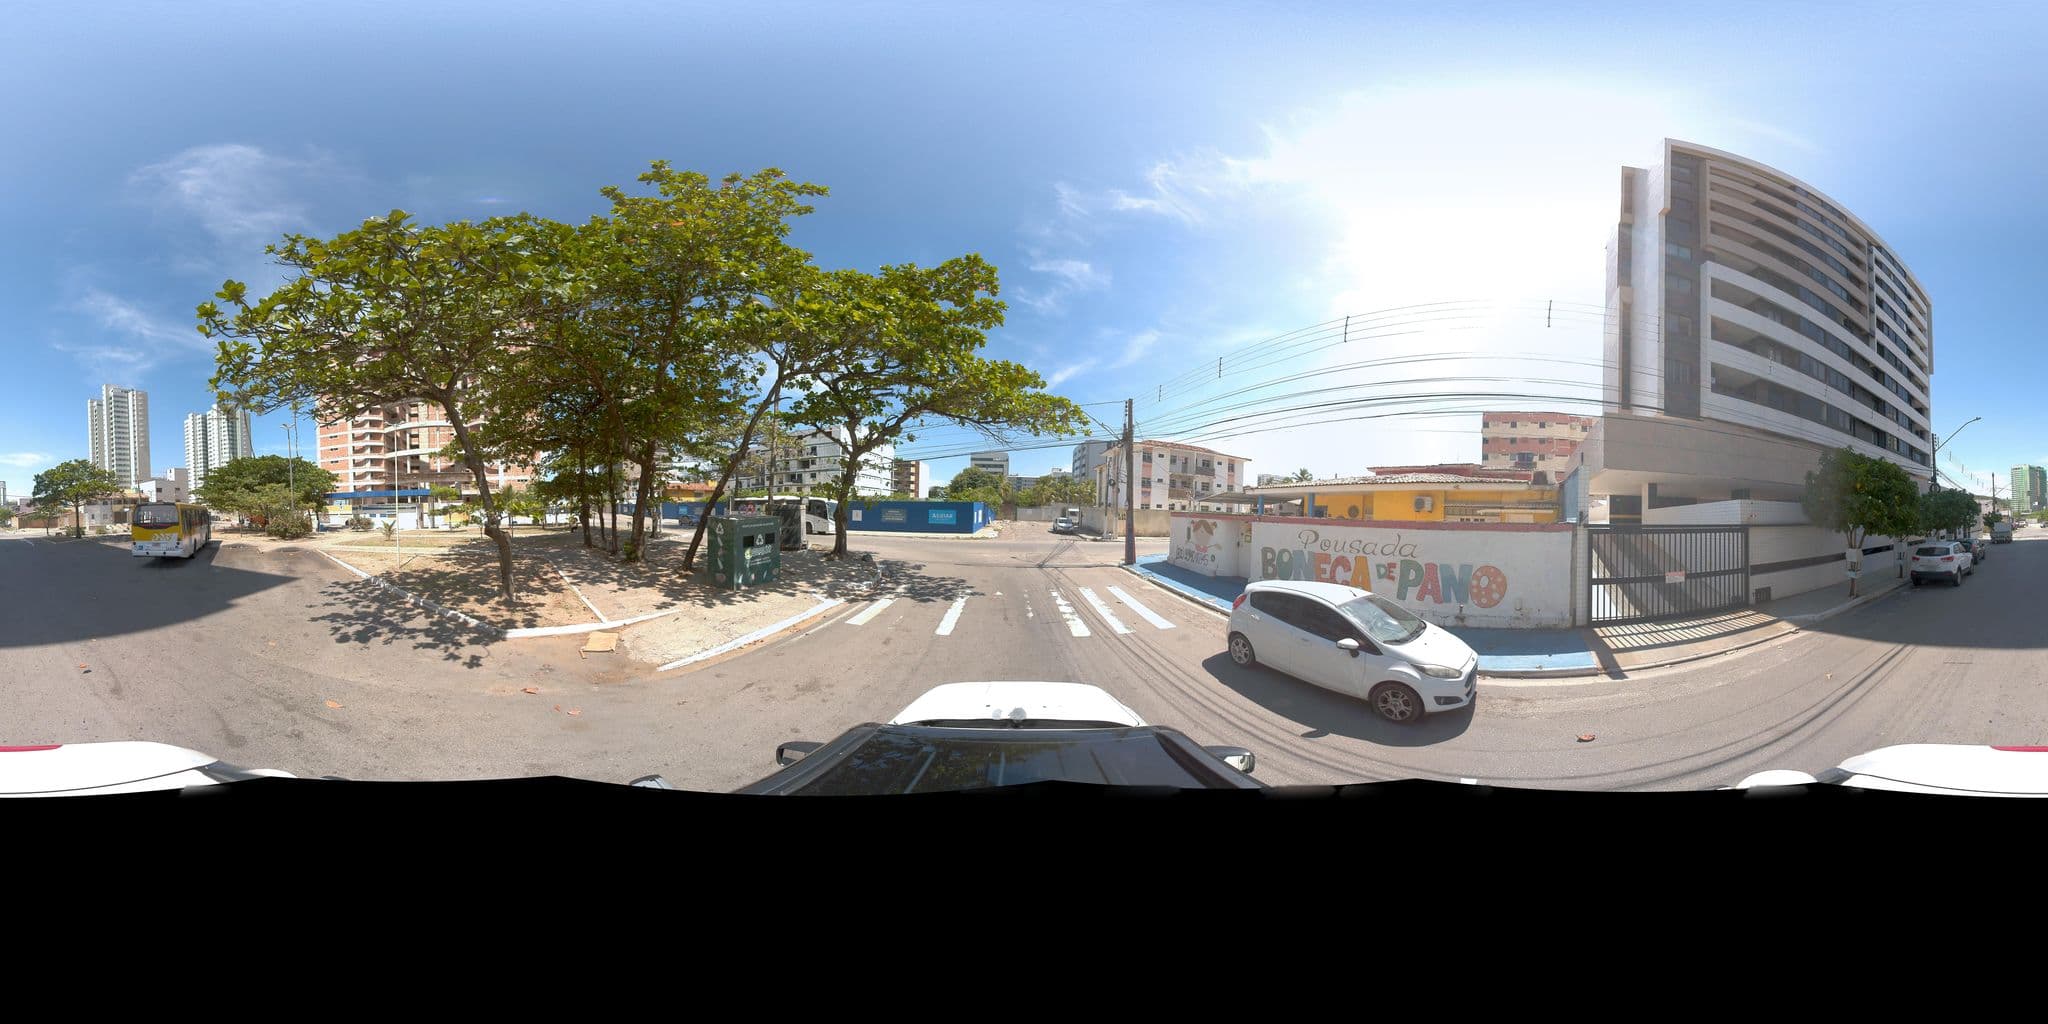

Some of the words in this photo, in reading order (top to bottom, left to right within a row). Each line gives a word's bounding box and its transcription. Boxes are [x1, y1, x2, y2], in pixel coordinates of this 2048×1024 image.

[1298, 529, 1418, 559] Pousada
[1261, 546, 1373, 592] BONECA
[1376, 562, 1397, 582] DE
[1397, 559, 1508, 609] PANO
